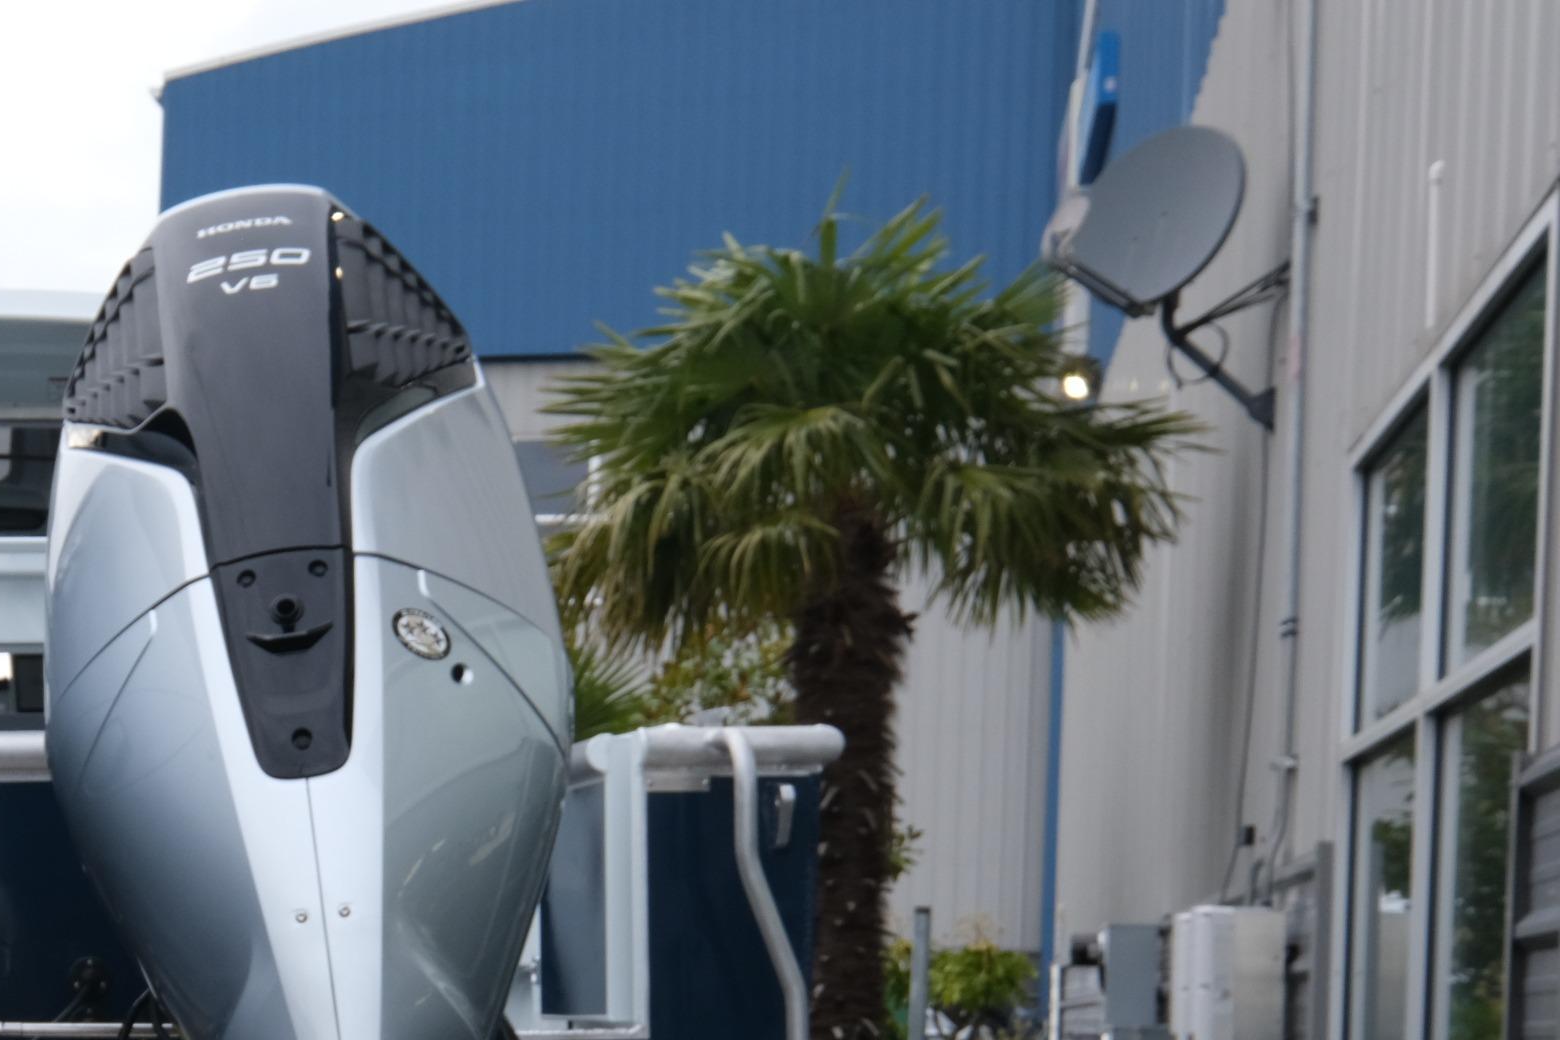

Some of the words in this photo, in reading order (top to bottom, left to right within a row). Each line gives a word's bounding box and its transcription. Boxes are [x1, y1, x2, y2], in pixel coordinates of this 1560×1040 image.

[196, 215, 292, 239] HONDA
[187, 247, 311, 284] 250
[220, 272, 279, 295] V6
